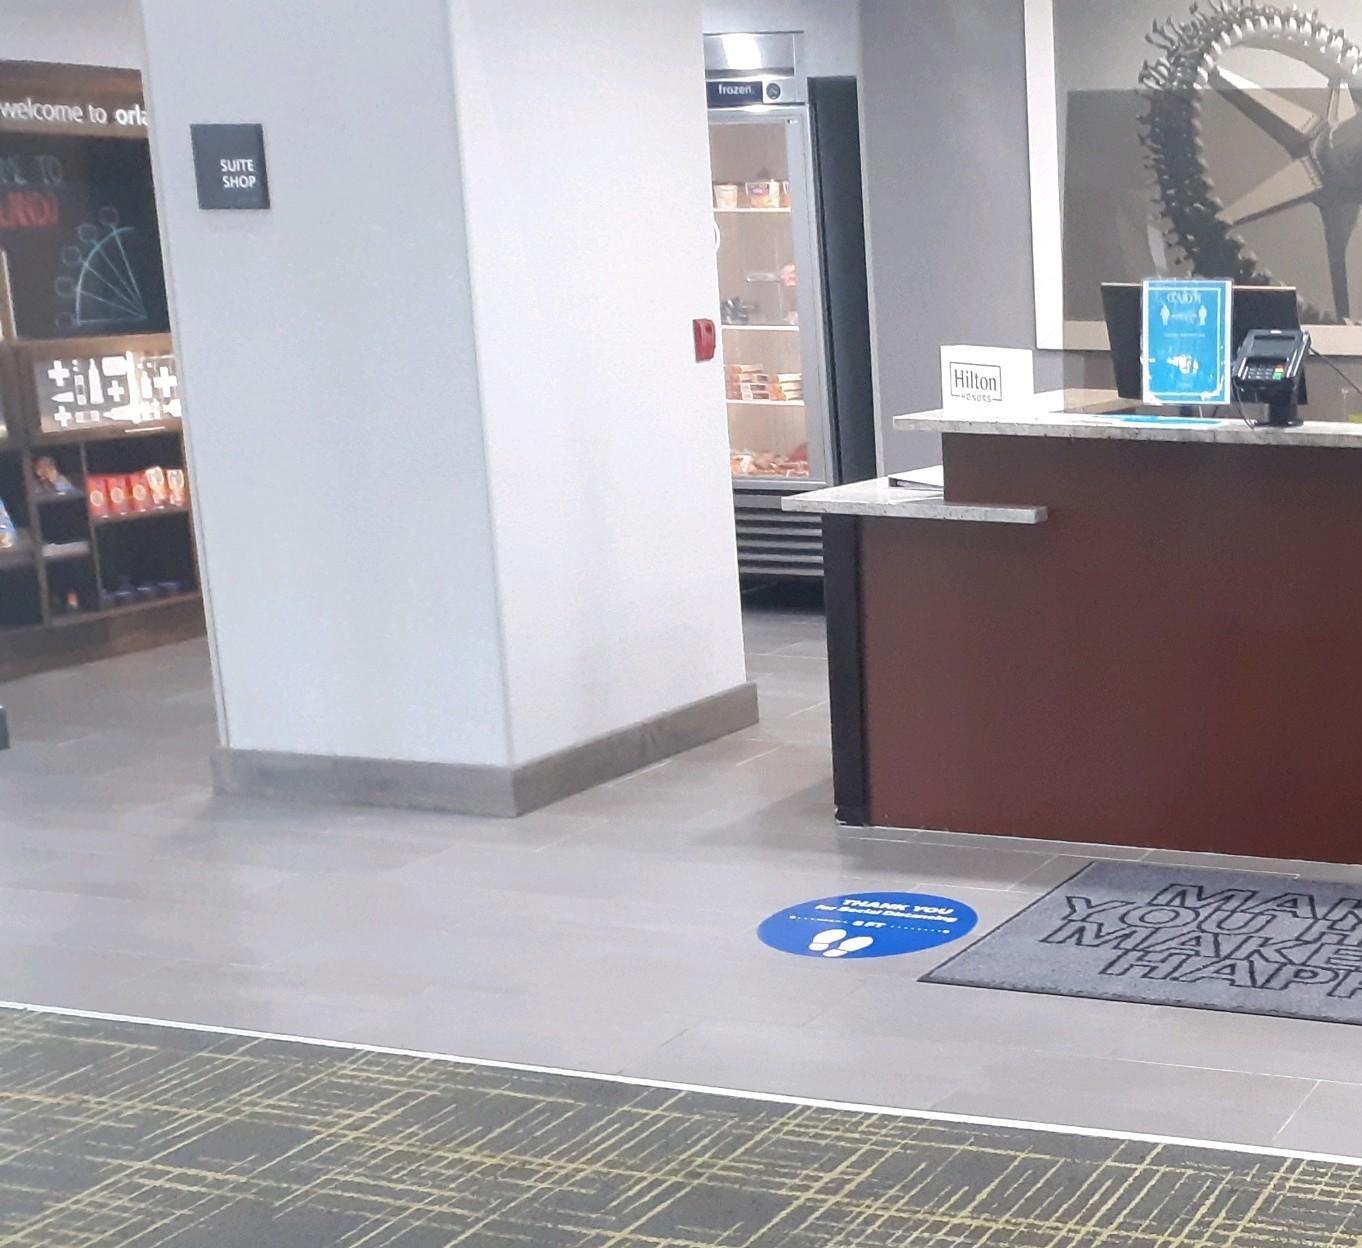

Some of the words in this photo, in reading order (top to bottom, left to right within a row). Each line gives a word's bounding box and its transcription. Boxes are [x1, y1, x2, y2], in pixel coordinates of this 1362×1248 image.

[0, 97, 83, 122] welcome
[88, 104, 107, 124] to
[220, 159, 254, 172] SUITE
[222, 175, 256, 188] SHOP
[954, 369, 997, 391] Hilton
[838, 906, 883, 915] Social
[883, 910, 959, 923] Distancing
[842, 898, 910, 911] THANK
[913, 905, 954, 915] YOU
[1062, 896, 1278, 936] YOU
